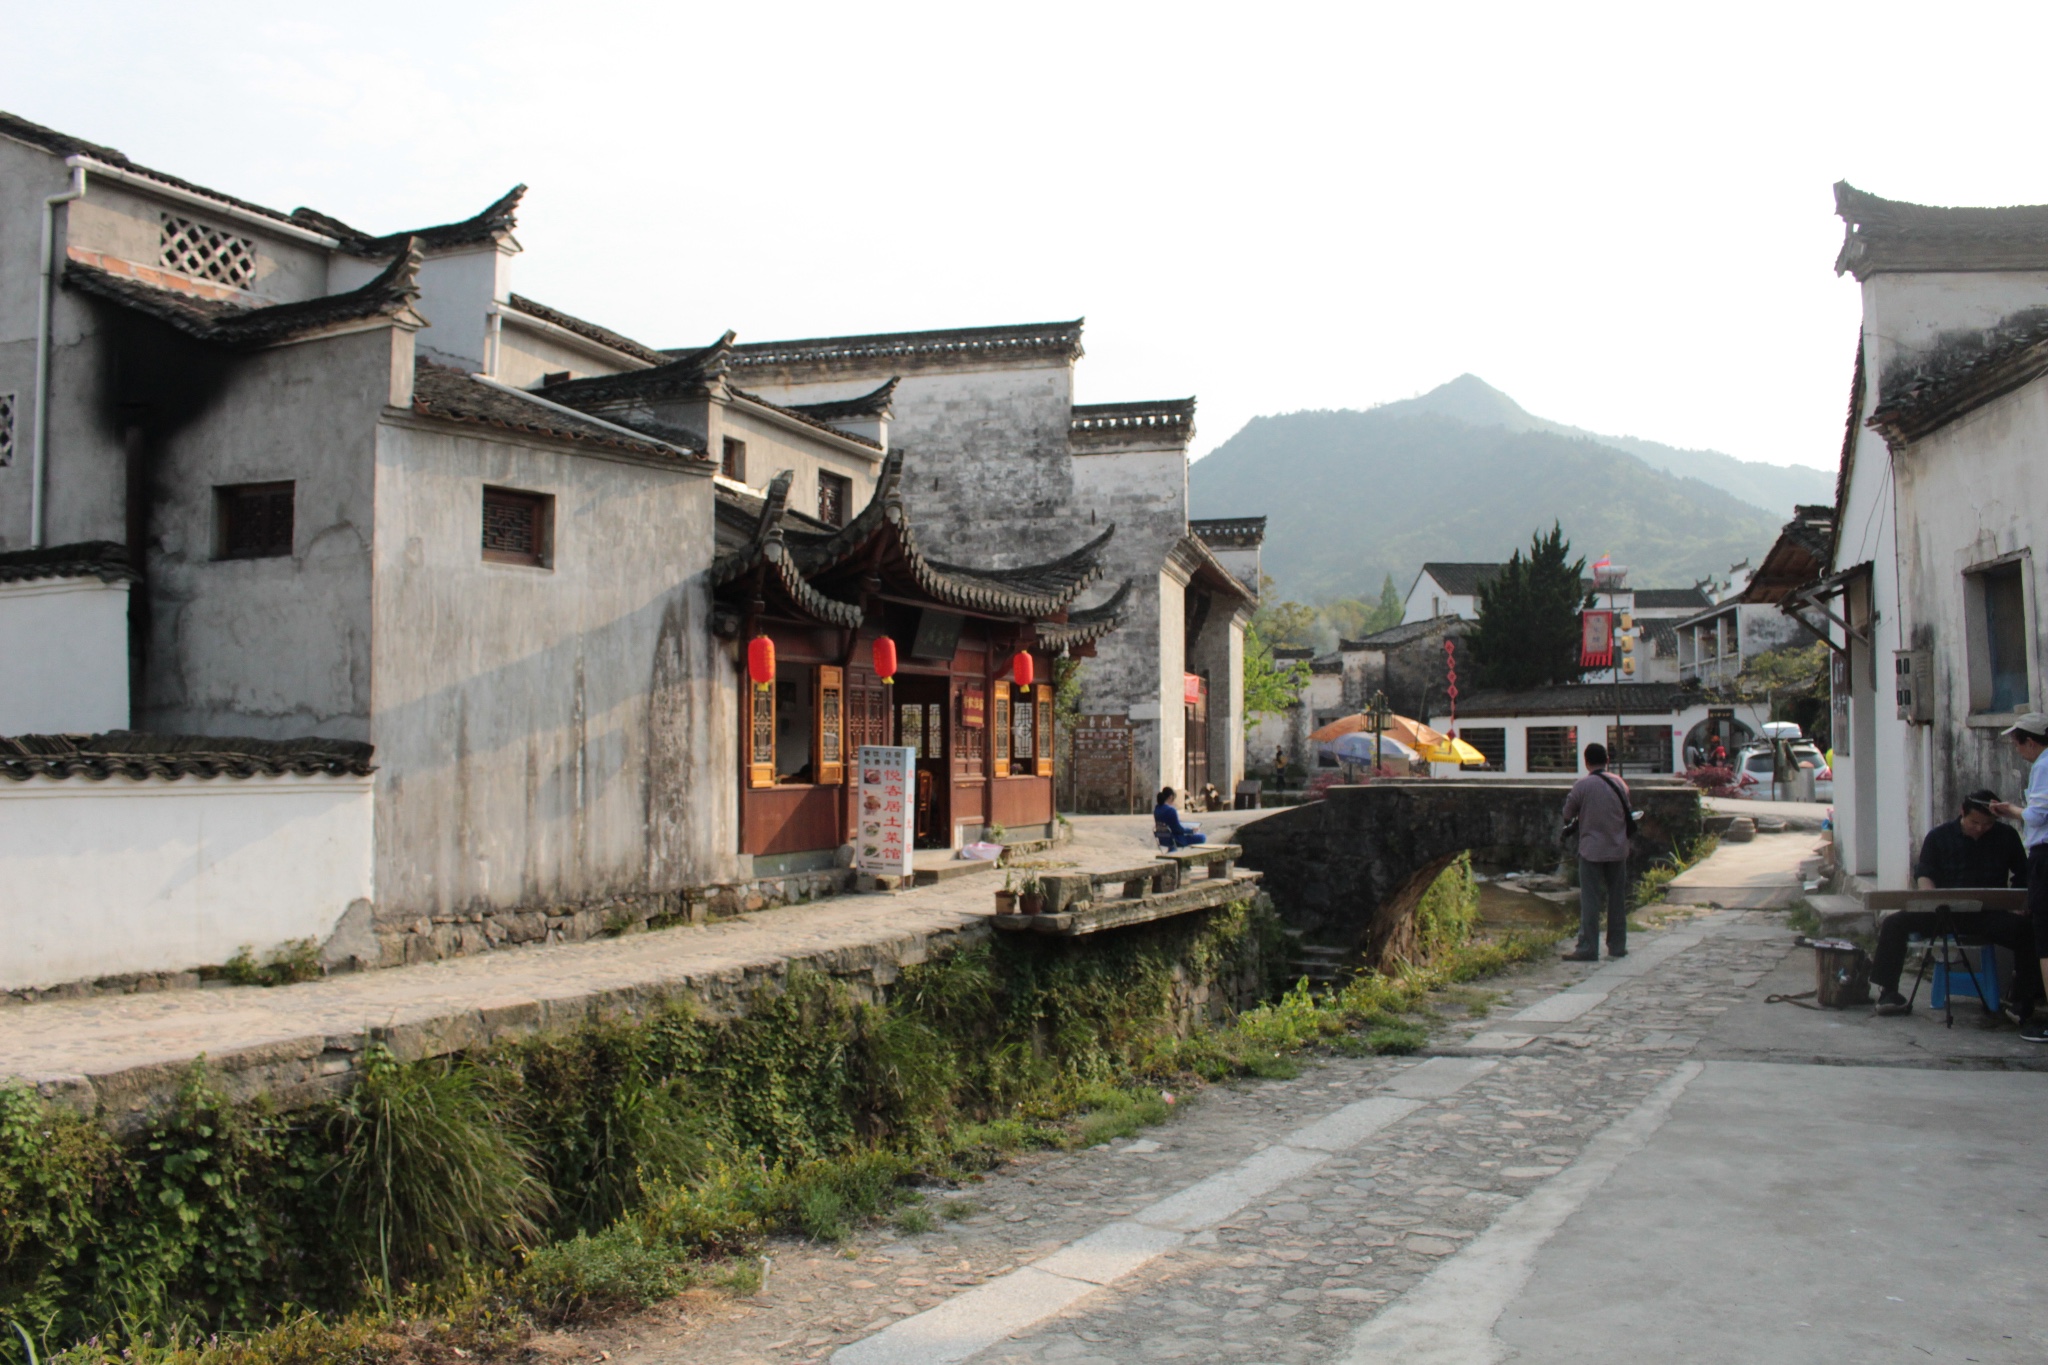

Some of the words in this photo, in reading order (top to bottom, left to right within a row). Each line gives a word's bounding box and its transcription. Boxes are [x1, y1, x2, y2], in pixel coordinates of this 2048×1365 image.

[882, 769, 903, 860] 悦客居土菜馆
